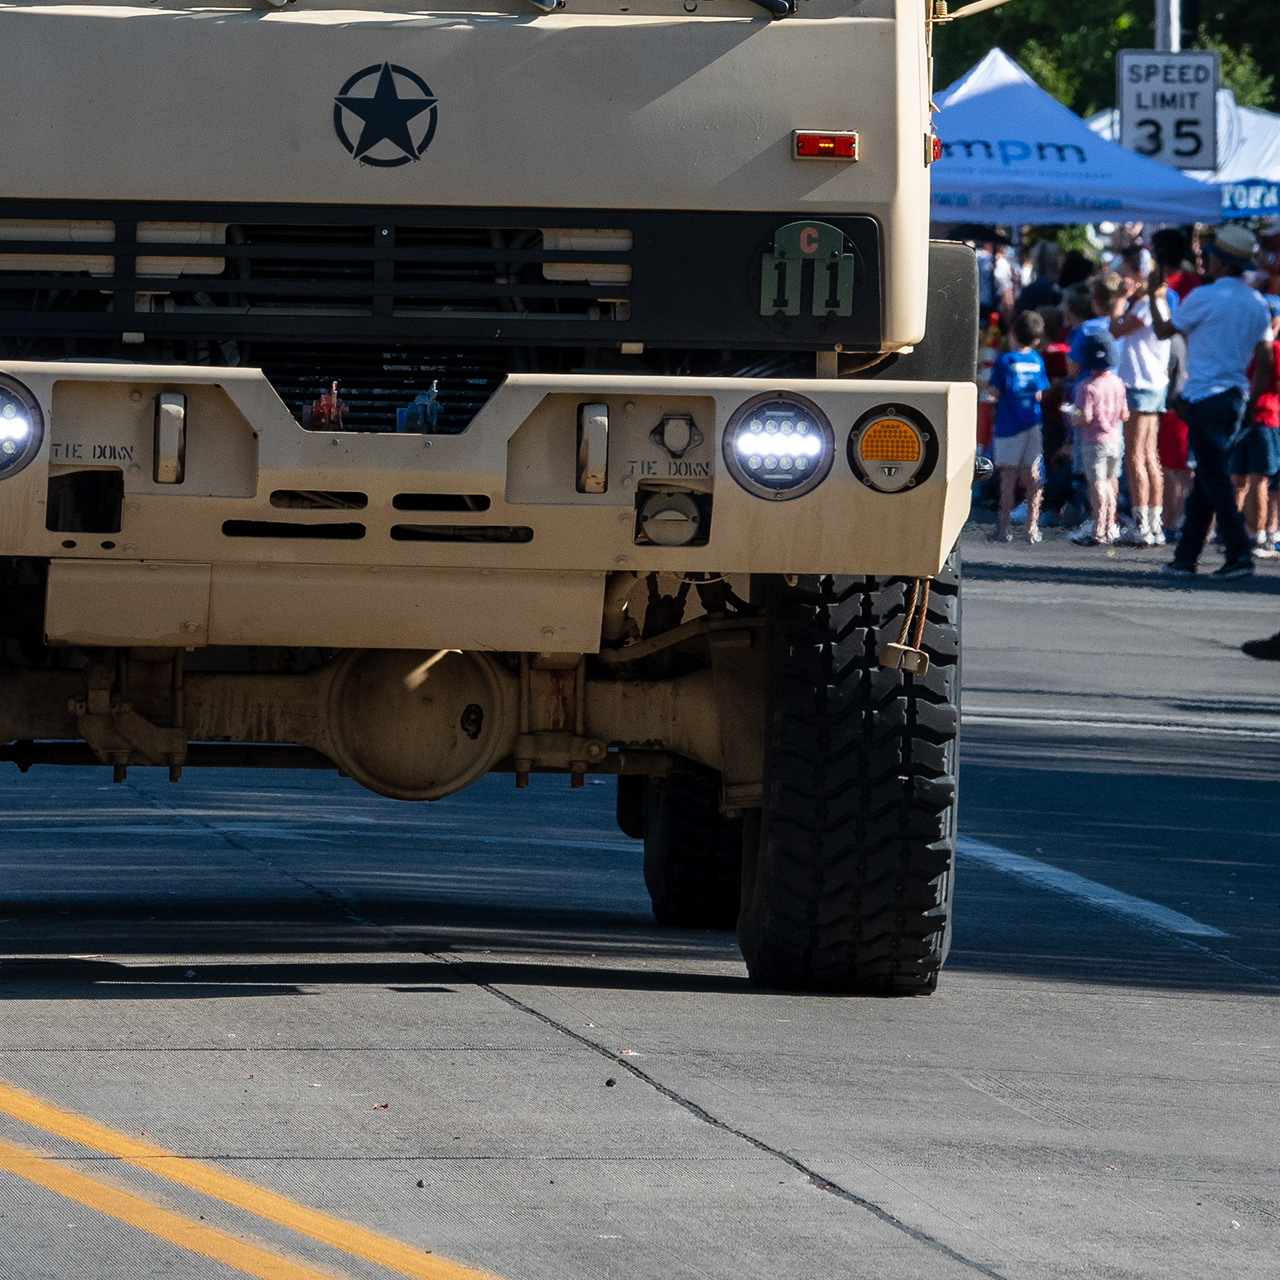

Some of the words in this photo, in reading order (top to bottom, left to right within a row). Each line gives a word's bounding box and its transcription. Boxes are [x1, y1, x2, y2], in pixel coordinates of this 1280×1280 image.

[1127, 63, 1210, 84] SPEED
[1135, 92, 1198, 110] LIMIT
[1135, 119, 1203, 157] 35
[800, 227, 818, 253] C
[52, 443, 82, 458] TIE
[93, 445, 133, 460] DOWN
[628, 460, 657, 475] TIE
[668, 461, 709, 476] DOWN
